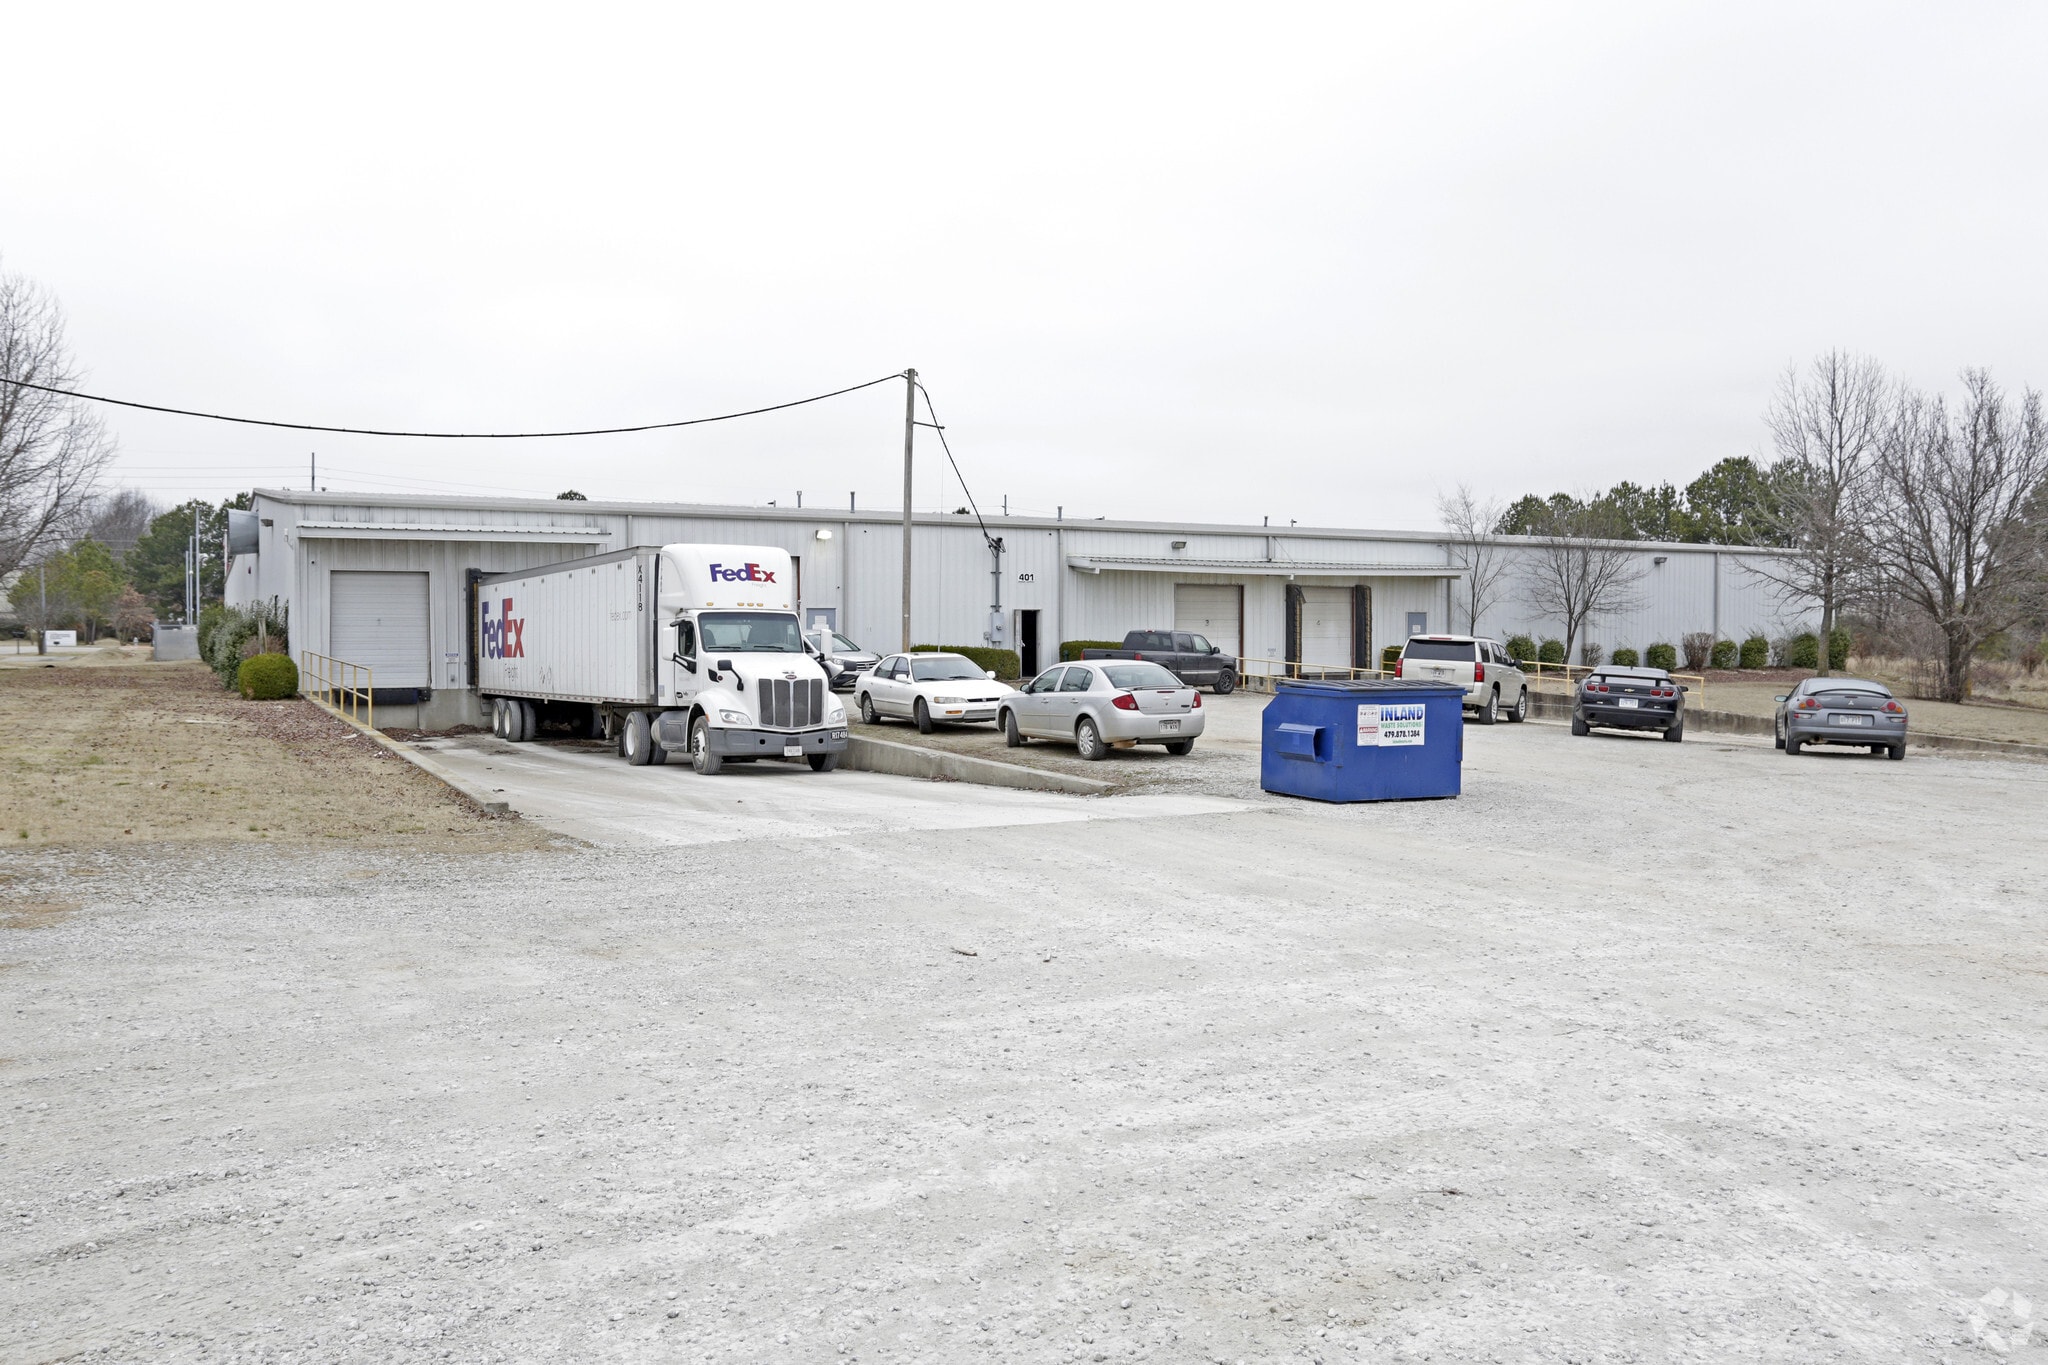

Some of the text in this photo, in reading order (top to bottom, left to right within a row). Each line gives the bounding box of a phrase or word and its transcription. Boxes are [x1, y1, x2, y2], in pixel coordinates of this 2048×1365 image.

[709, 563, 777, 583] FedEx
[1018, 573, 1034, 581] 401
[481, 597, 525, 660] FedEx
[1380, 706, 1424, 721] INLAND
